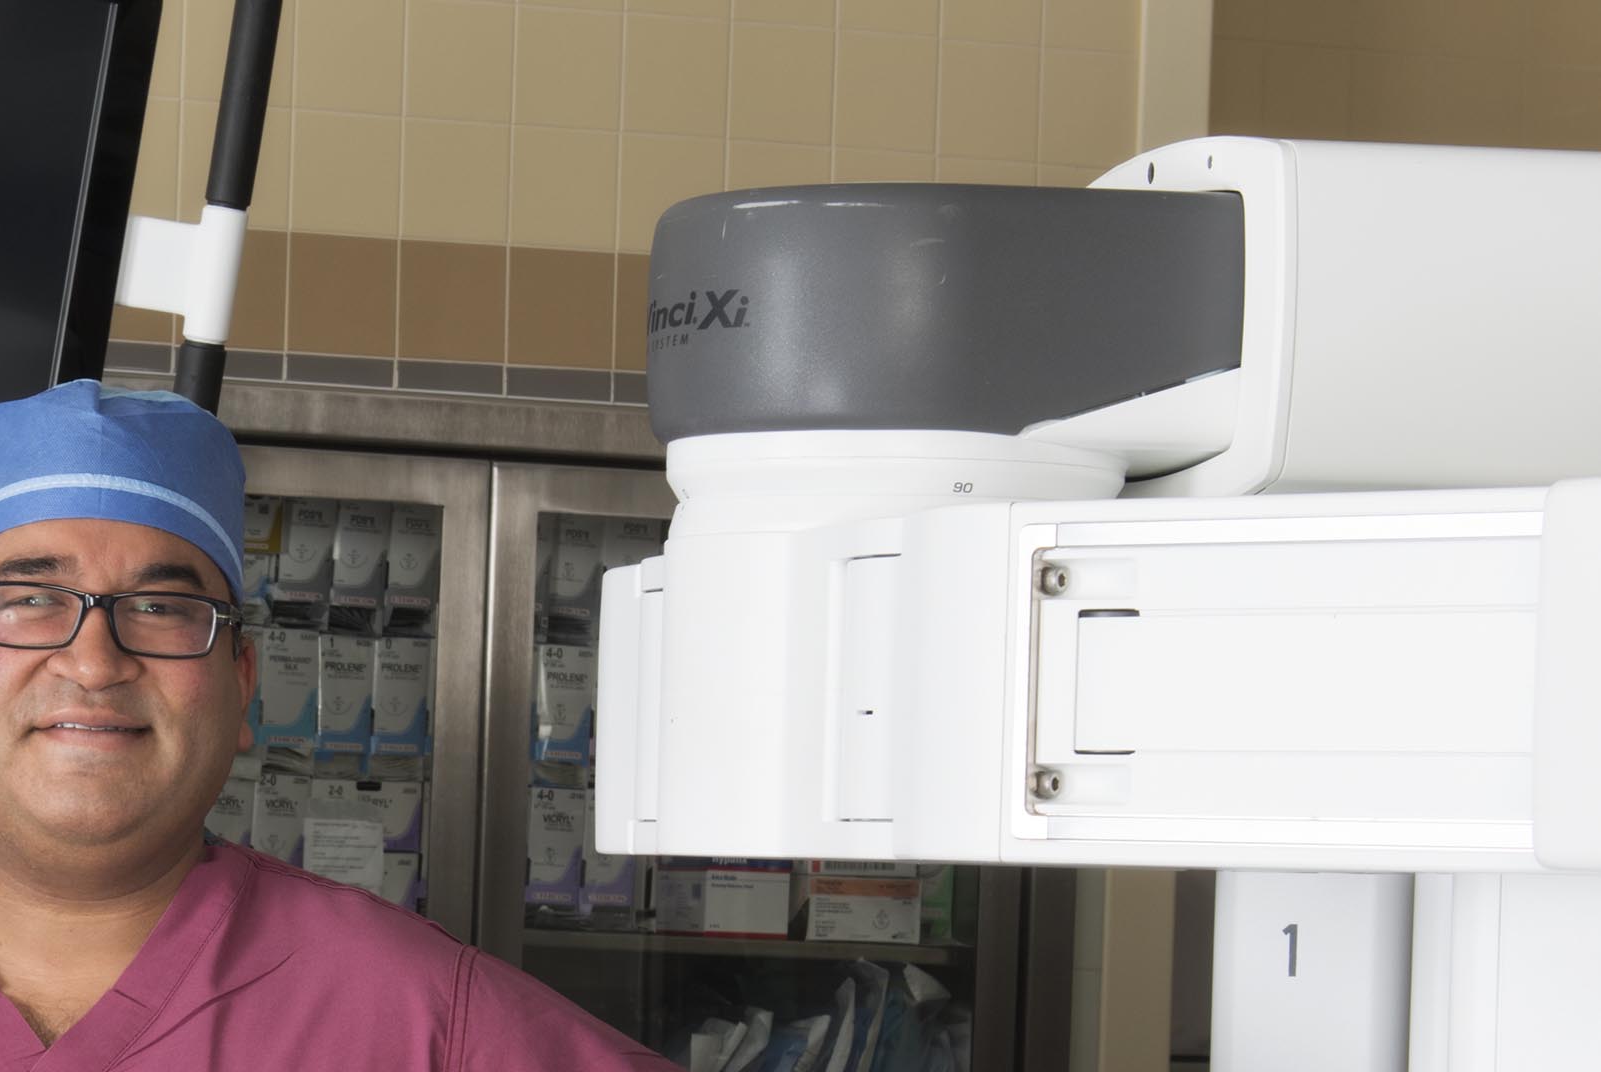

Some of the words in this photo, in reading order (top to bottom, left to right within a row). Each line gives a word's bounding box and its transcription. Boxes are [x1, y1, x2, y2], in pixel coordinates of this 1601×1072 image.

[697, 288, 748, 330] Xi
[952, 481, 973, 494] 90
[268, 631, 286, 643] 4-0
[329, 637, 335, 648] 1
[385, 638, 392, 649] 0
[1281, 923, 1299, 977] 1
